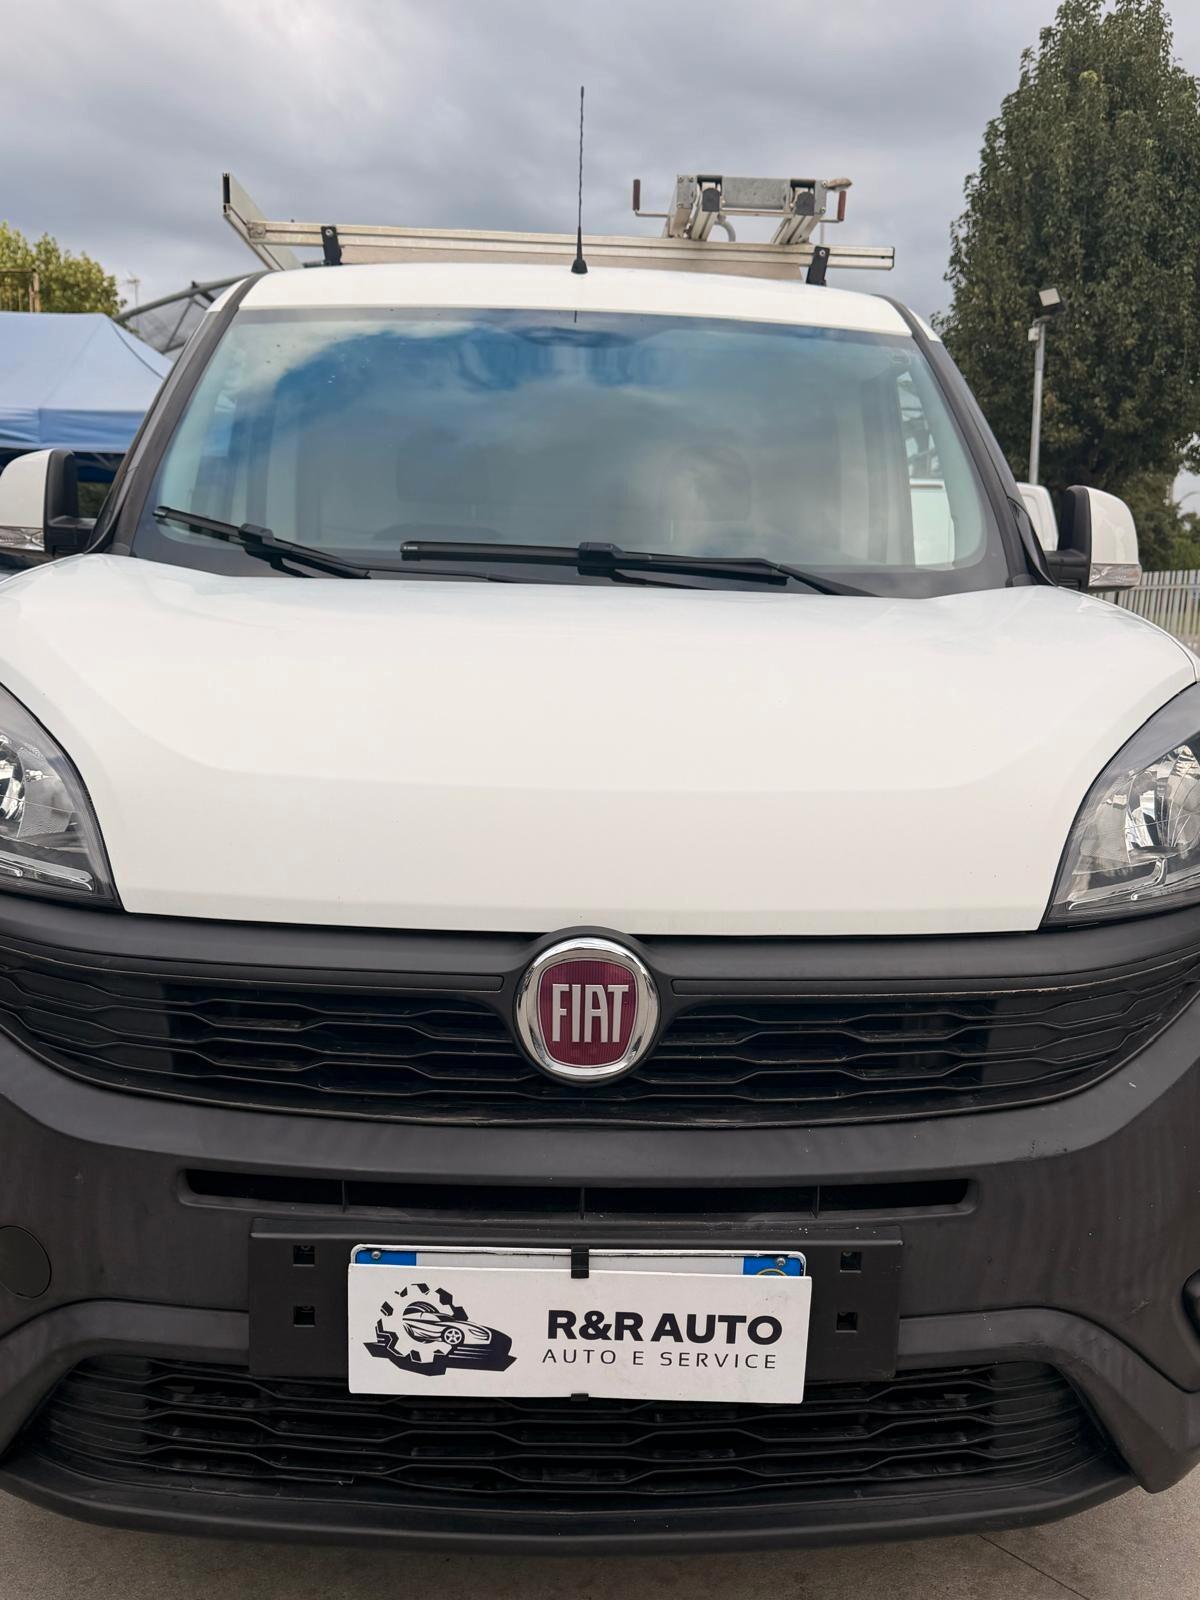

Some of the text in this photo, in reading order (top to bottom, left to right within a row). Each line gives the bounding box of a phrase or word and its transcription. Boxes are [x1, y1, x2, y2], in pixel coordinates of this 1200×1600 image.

[552, 983, 629, 1043] FIAT
[547, 1309, 783, 1346] R&R AUTO
[542, 1348, 777, 1369] AUTO E SERVICE
